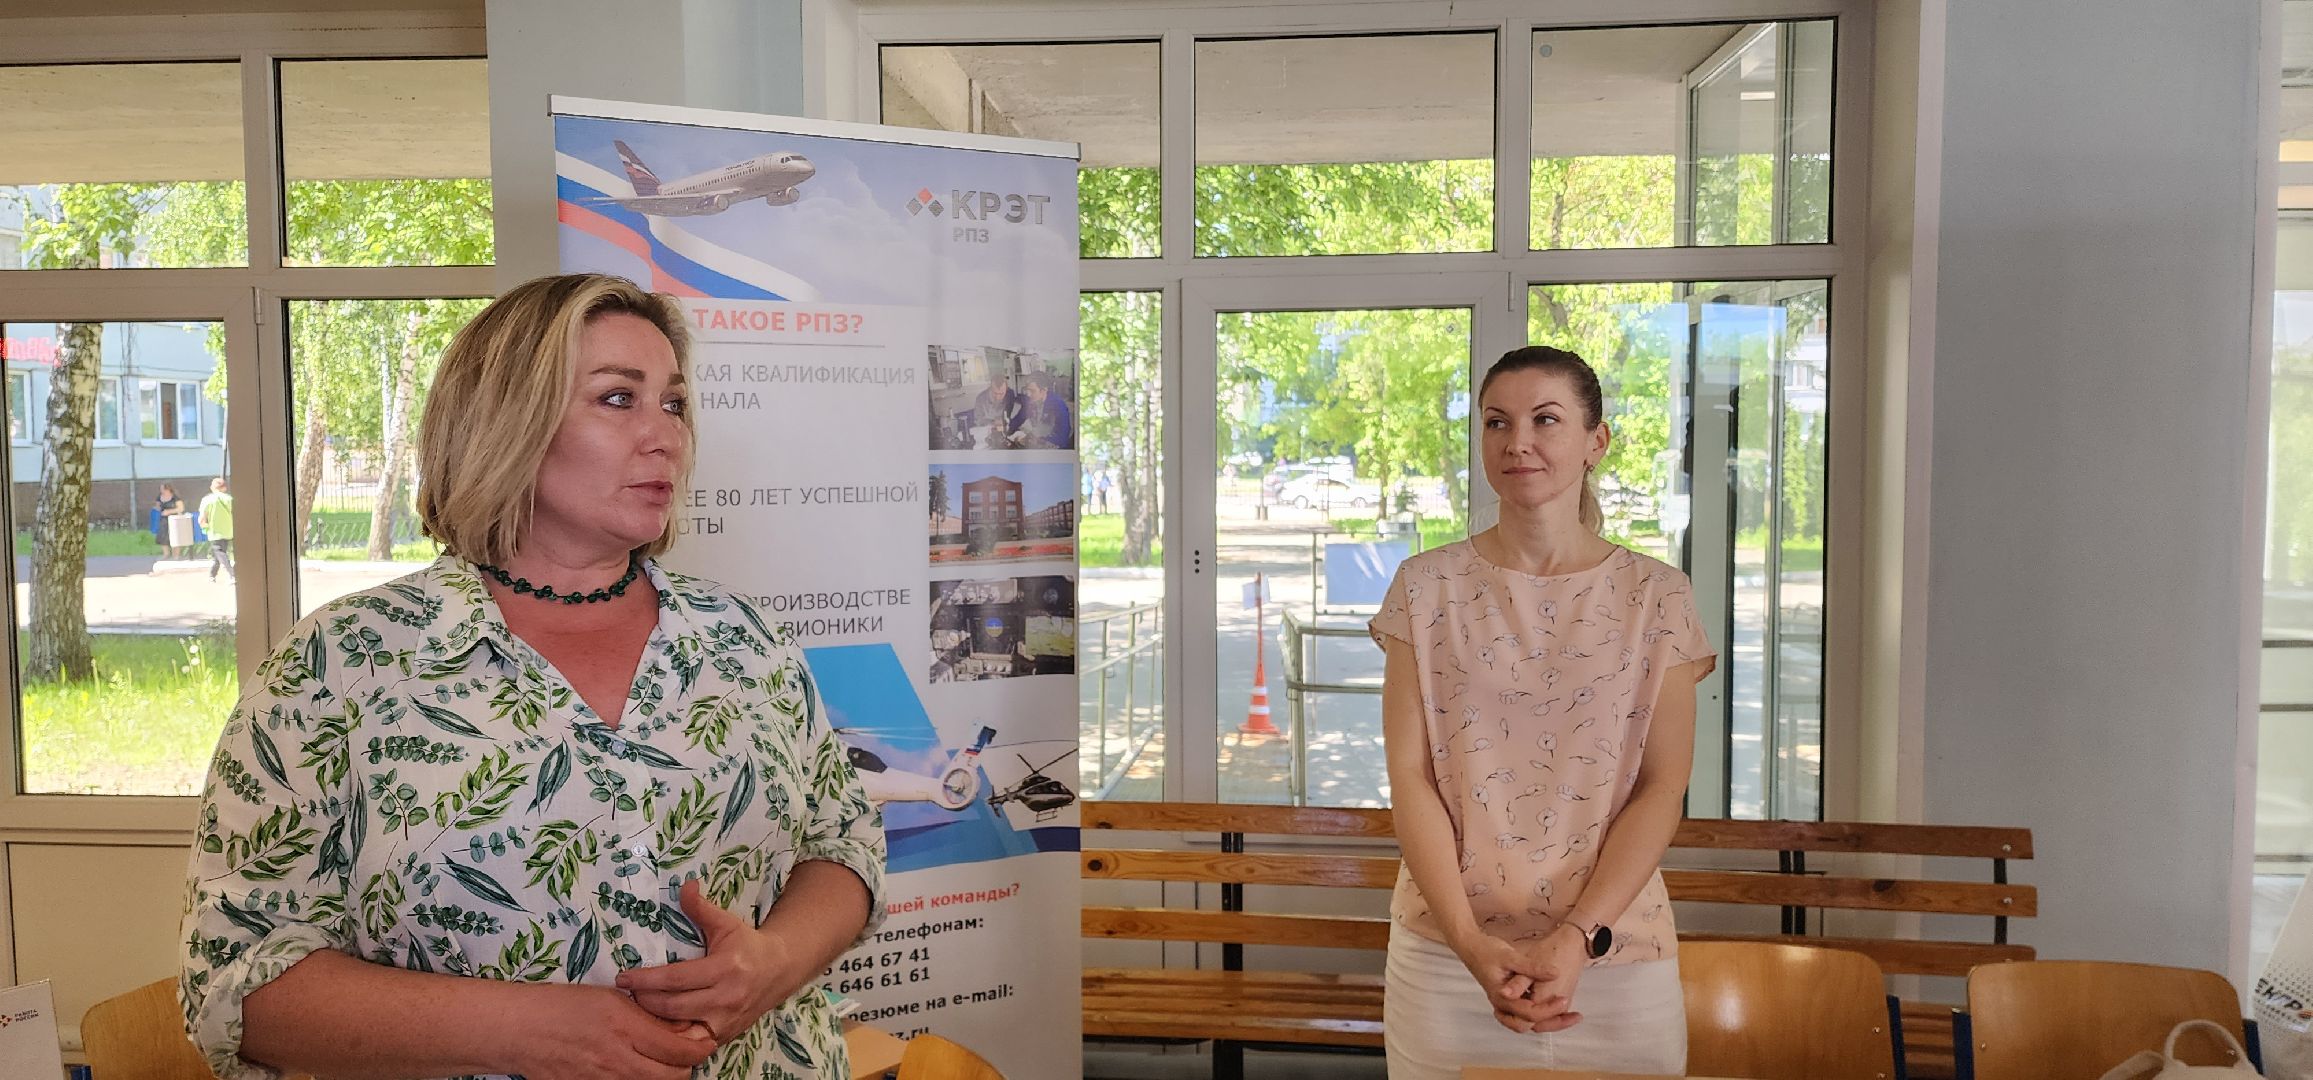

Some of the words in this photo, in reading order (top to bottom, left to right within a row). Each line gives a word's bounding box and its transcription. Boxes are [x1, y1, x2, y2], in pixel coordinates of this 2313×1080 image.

[951, 188, 1051, 225] КРЭТ
[952, 227, 990, 244] РПЗ
[692, 308, 785, 333] ТАКОЕ
[795, 311, 864, 335] РПЗ?
[742, 363, 915, 388] КВАЛИФИКАЦИЯ
[700, 391, 761, 411] НАЛА
[716, 488, 741, 507] 80
[750, 488, 792, 507] ЛЕТ
[800, 481, 918, 506] УСПЕШНОЙ
[752, 587, 912, 613] РОИЗВОДСТВЕ
[778, 615, 884, 638] ВИОНИКИ
[930, 882, 1020, 908] команды?
[874, 916, 984, 944] телефонам:
[839, 955, 874, 974] 464
[880, 950, 902, 967] 67
[909, 946, 930, 962] 41
[839, 976, 874, 994] 646
[880, 971, 902, 987] 61
[909, 966, 930, 982] 61
[926, 996, 947, 1010] на
[952, 983, 1014, 1006] e-mail:
